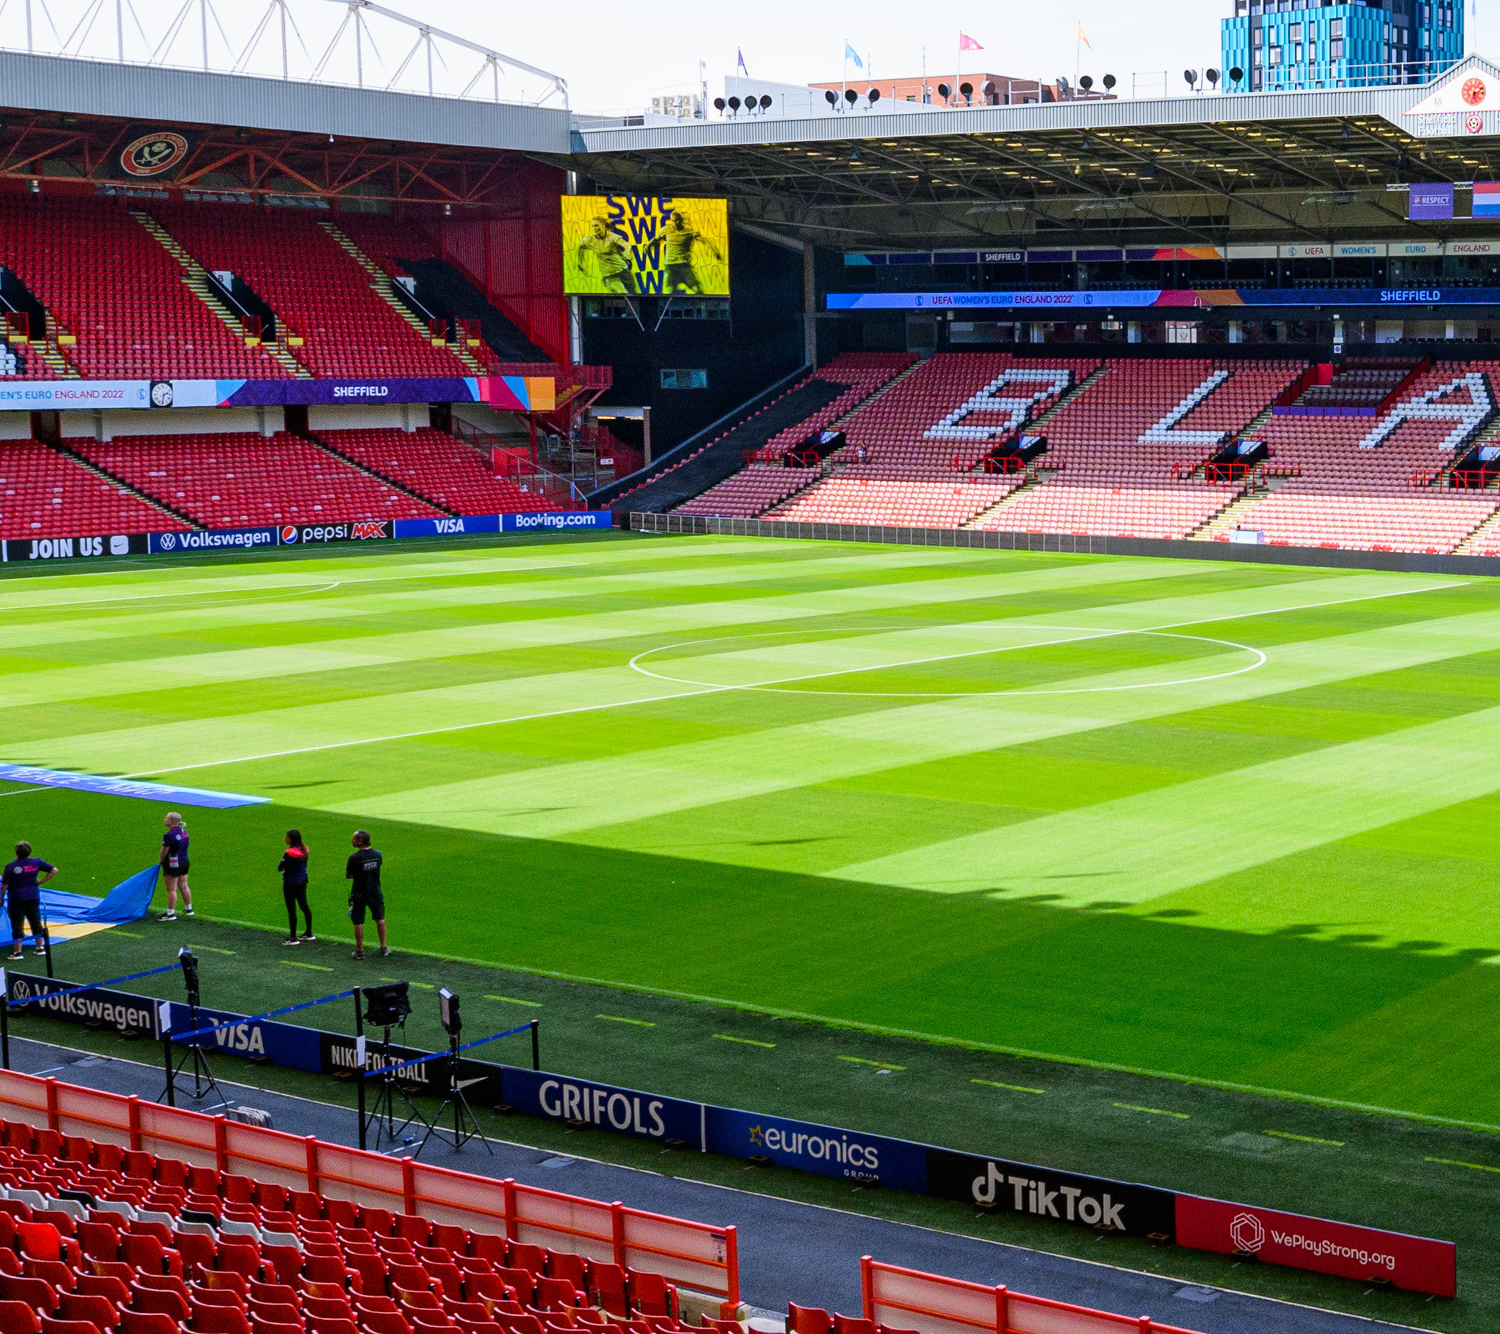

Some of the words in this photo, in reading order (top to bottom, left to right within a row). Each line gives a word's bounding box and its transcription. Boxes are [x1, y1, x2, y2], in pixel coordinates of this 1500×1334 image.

[1422, 197, 1449, 205] RESPECT
[985, 253, 1021, 261] SHEFFIELD
[1304, 247, 1324, 255] UEFA
[1341, 246, 1376, 254] WOMEN'S
[932, 297, 953, 305] UEFA
[991, 296, 1013, 304] EURO
[1014, 296, 1053, 304] ENGLAND
[1053, 295, 1073, 303] 2022
[1380, 290, 1441, 301] SHEFFIELD
[25, 390, 52, 401] EURO
[54, 389, 100, 401] ENGLAND
[101, 388, 124, 400] 2022
[333, 384, 388, 399] SHEFFIELD
[433, 517, 465, 534] VISA
[516, 512, 596, 529] Booking.com
[179, 529, 271, 548] Volkswagen
[302, 524, 348, 544] pepsi
[350, 521, 387, 539] MAX
[29, 538, 77, 560] JOIN
[80, 536, 103, 557] US
[34, 984, 150, 1030] Volkswagen
[209, 1018, 265, 1054] VISA
[538, 1079, 666, 1138] GRIFOLS
[764, 1127, 879, 1169] euronics
[1008, 1175, 1126, 1230] TikTok
[1271, 1229, 1396, 1271] WePlayStrong.org
